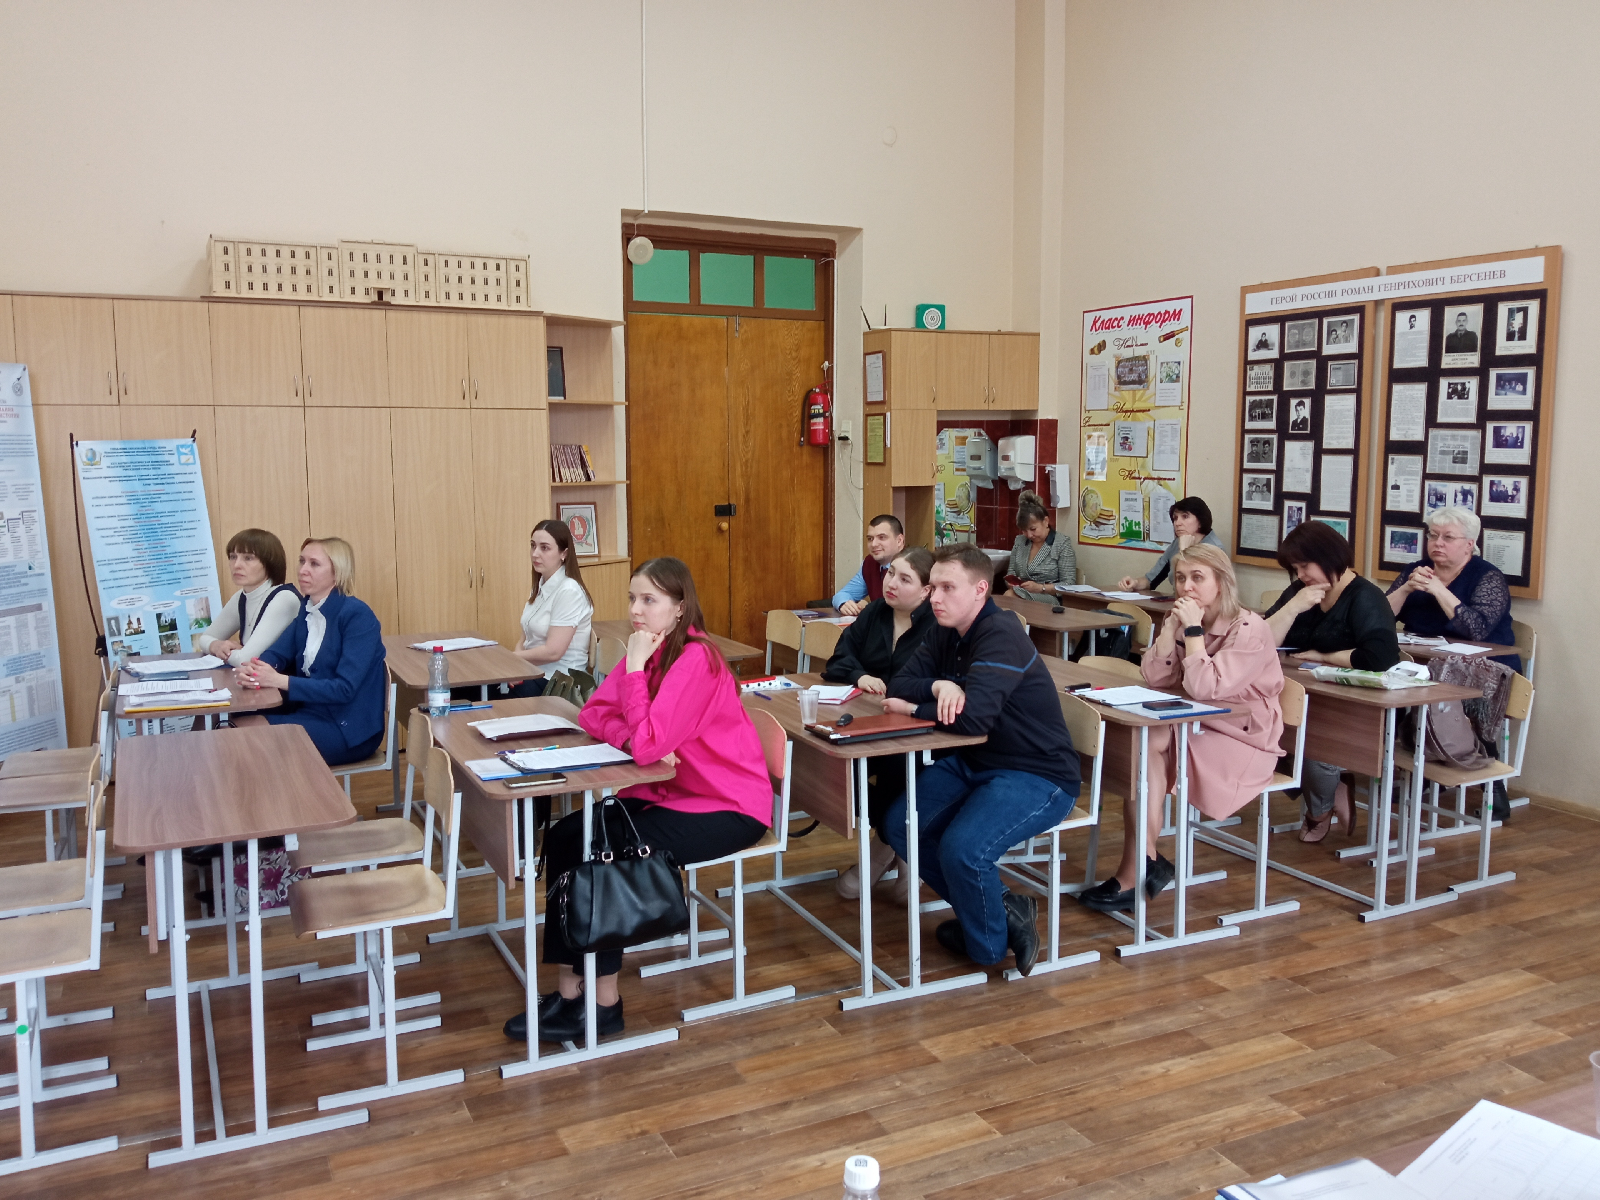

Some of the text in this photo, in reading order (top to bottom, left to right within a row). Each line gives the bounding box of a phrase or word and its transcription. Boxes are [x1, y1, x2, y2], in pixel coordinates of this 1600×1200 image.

[1270, 269, 1507, 305] ГЕРОЙ РОССИИ РОМАН ГЕНРИХОВИЧ БЕРСЕНЕВ
[1089, 308, 1183, 332] Класс информ
